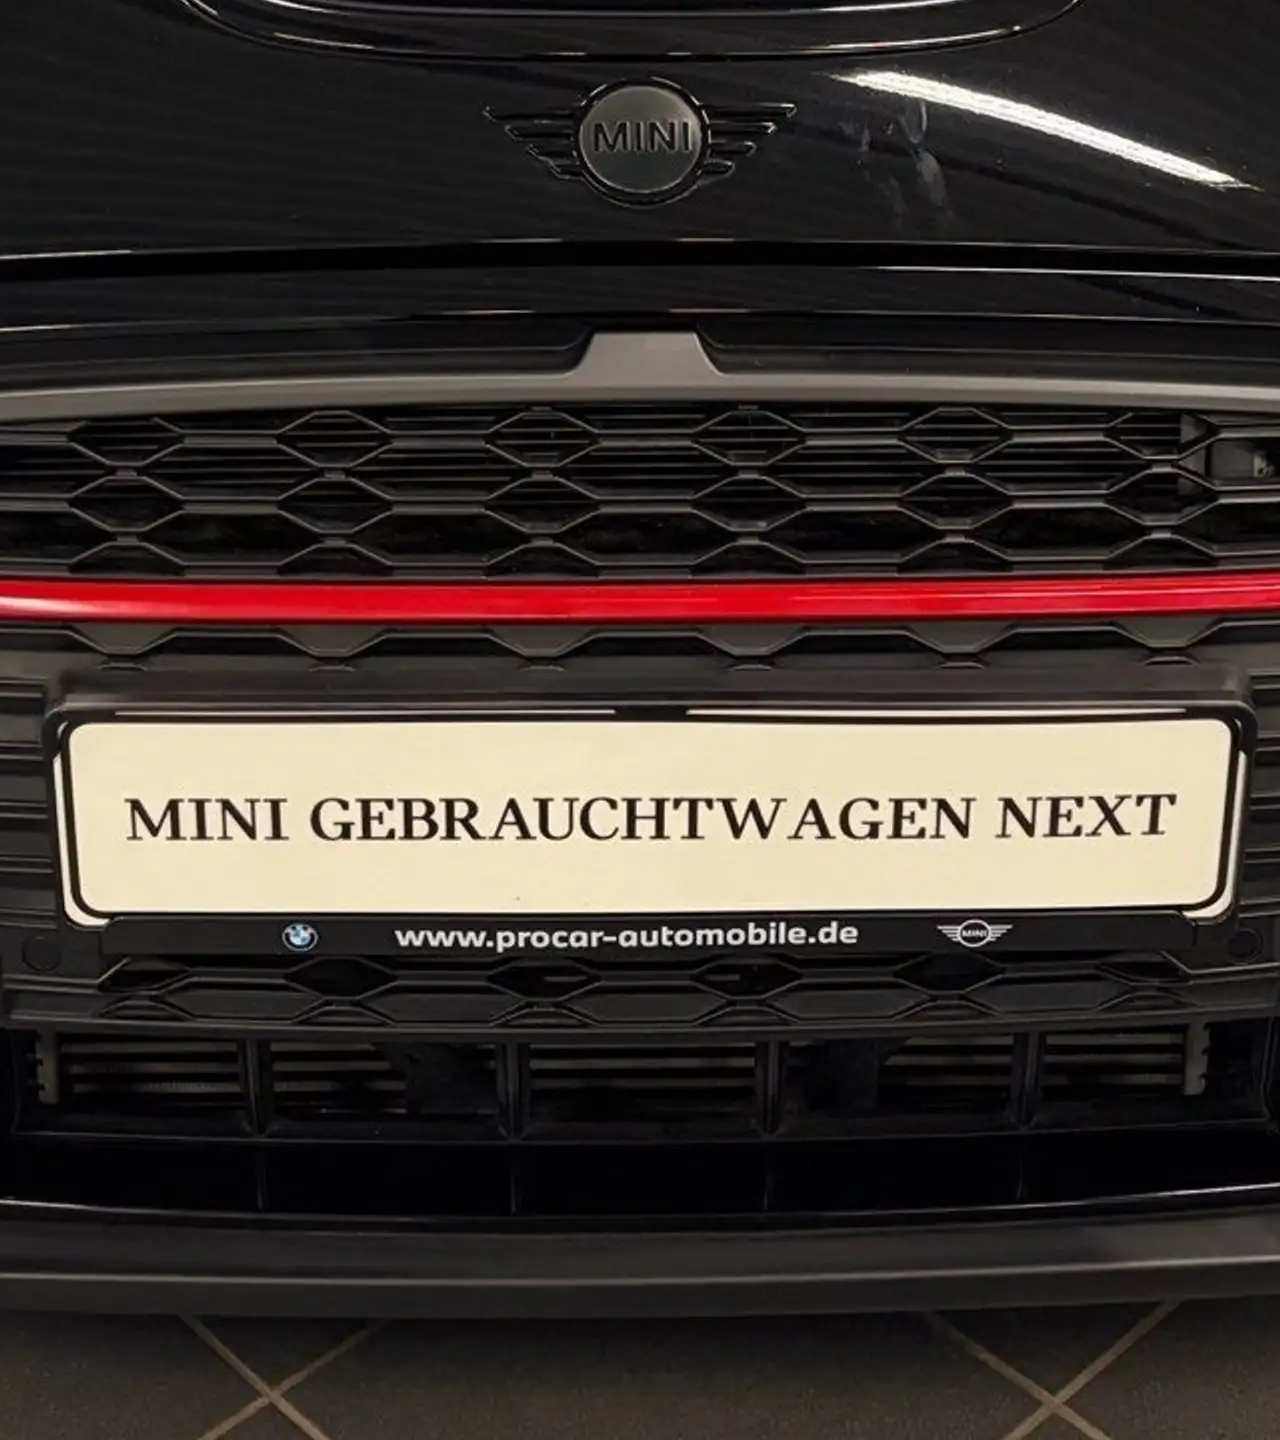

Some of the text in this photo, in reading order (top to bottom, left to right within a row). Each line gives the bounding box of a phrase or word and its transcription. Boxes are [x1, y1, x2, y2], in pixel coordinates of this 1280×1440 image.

[592, 119, 695, 154] MINI
[125, 793, 1177, 841] MINI GEBRAUCHTWAGEN NEXT
[394, 920, 859, 953] www.procar-automobile.de
